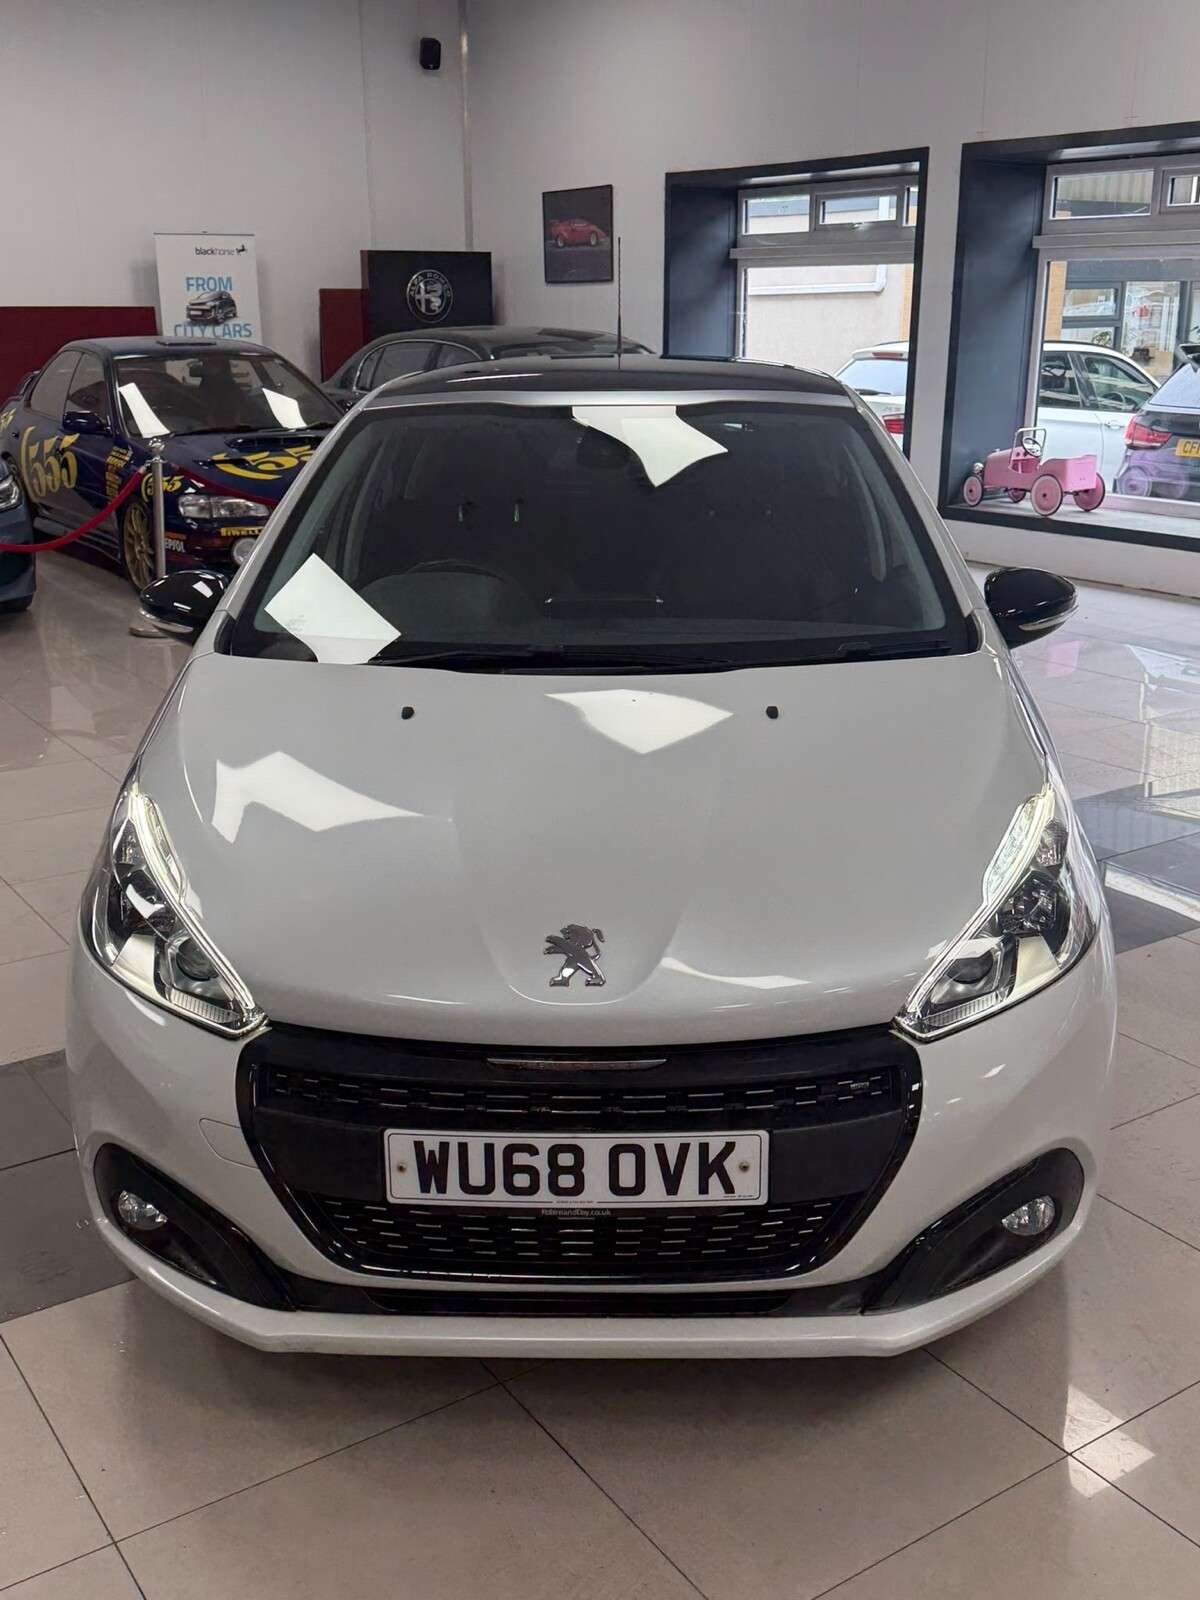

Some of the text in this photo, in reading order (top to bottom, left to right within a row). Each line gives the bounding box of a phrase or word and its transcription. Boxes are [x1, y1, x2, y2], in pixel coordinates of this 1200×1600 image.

[195, 247, 235, 256] blackhorse
[185, 276, 233, 292] FROM
[174, 323, 252, 338] CITY CARS
[1183, 440, 1200, 455] CF
[413, 1140, 736, 1197] WU68 OVK
